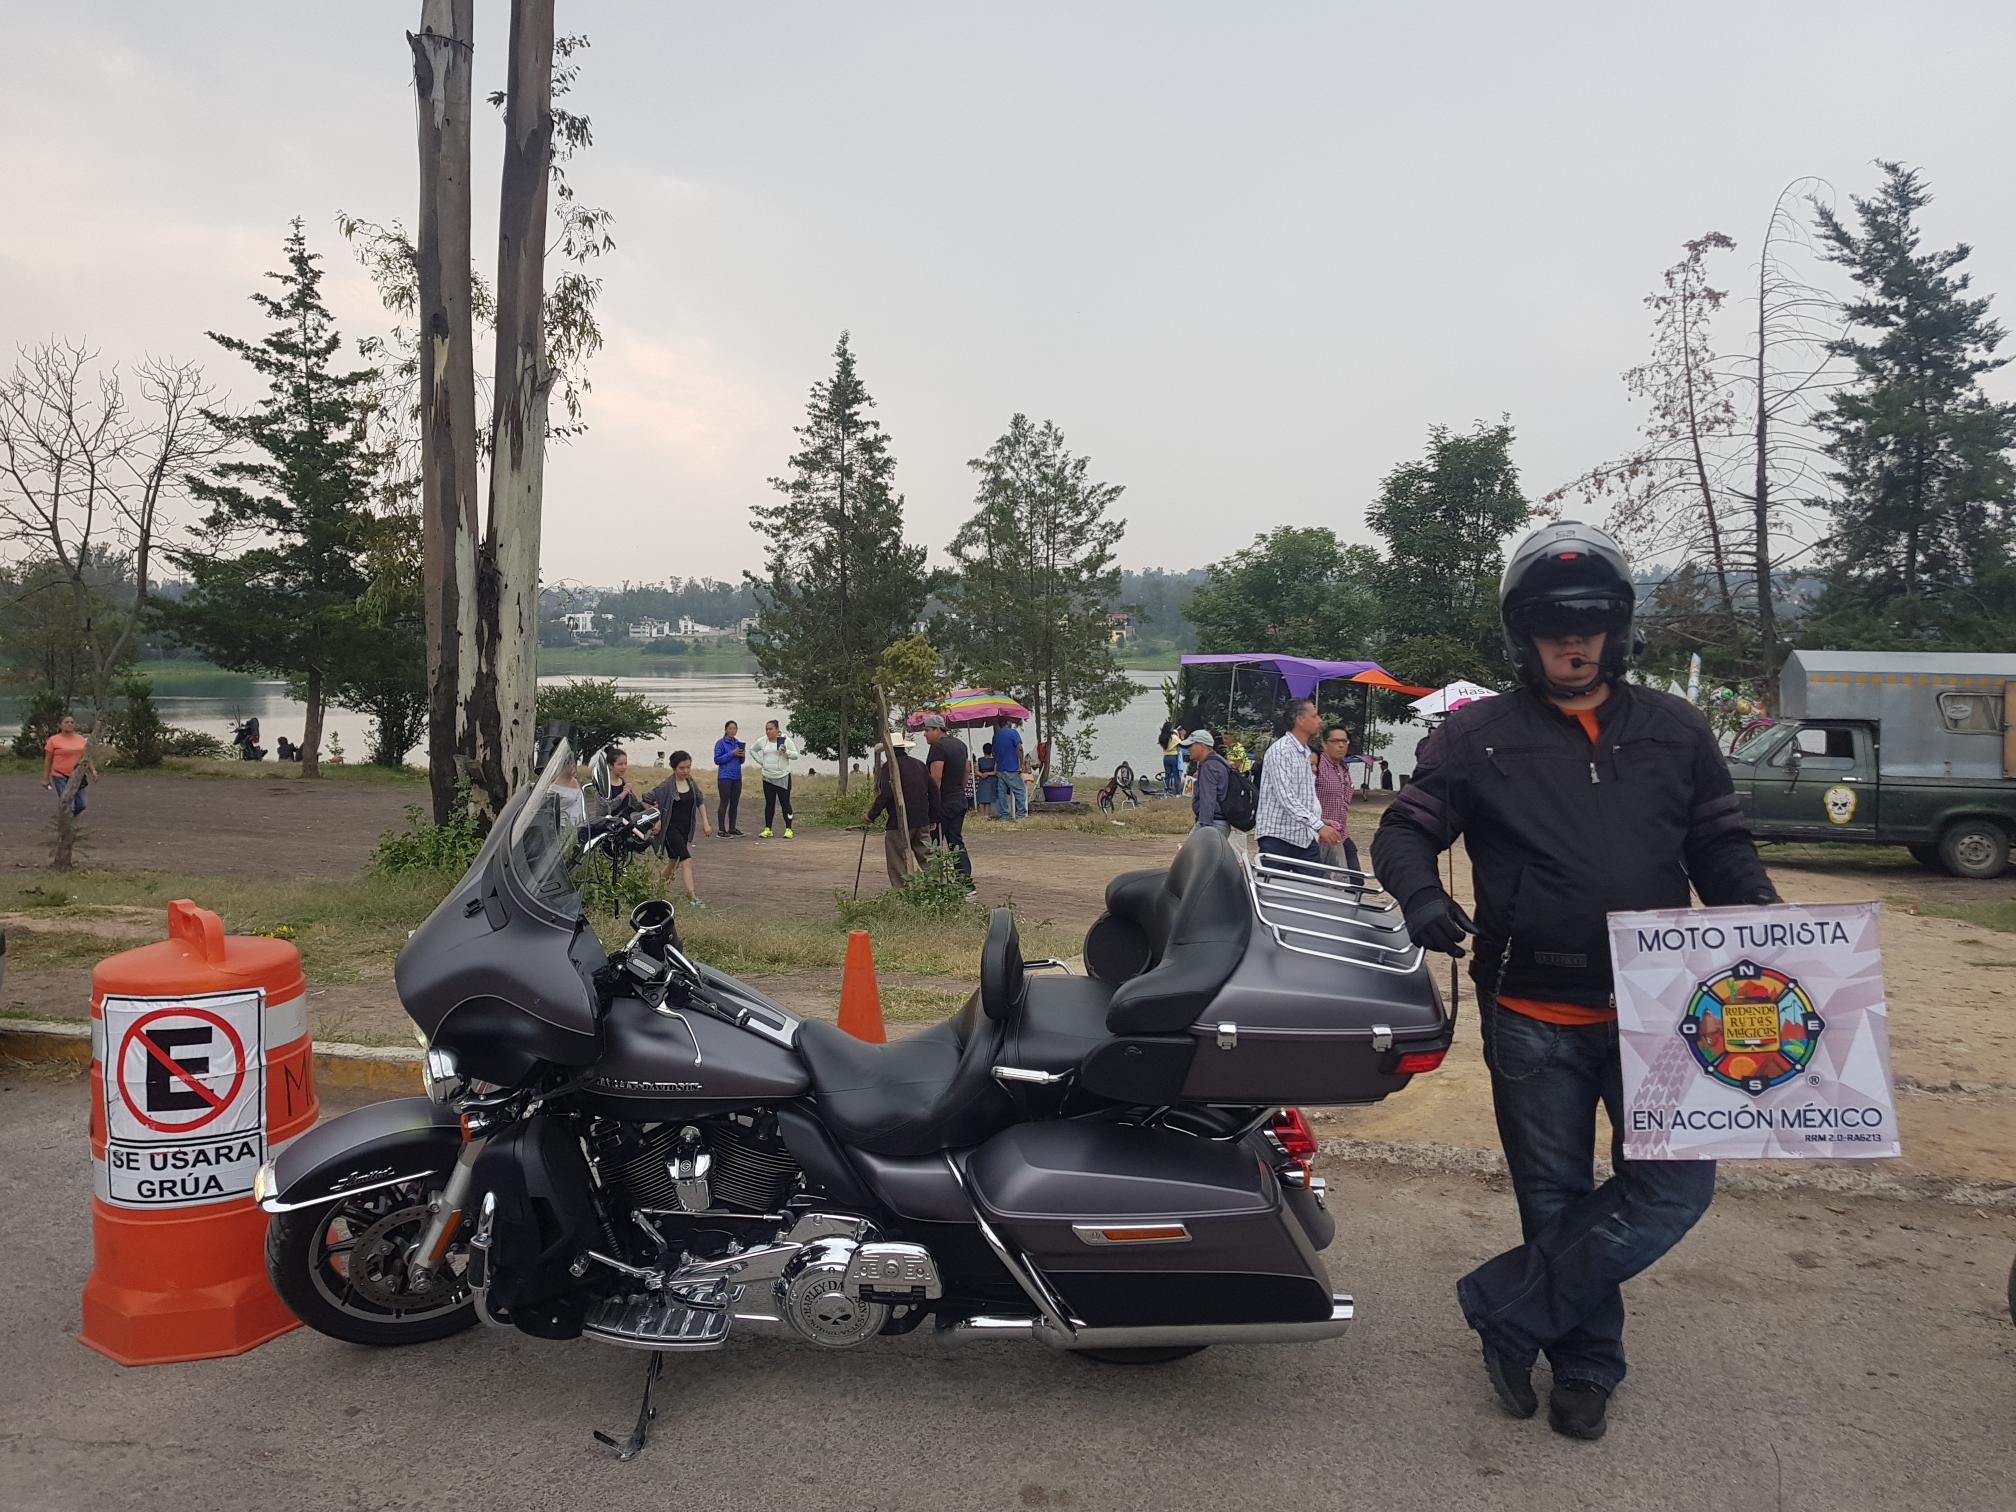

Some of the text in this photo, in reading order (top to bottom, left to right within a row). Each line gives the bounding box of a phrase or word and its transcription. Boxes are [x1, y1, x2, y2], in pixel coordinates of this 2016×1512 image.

[1637, 921, 1850, 952] MOTO TURISTA
[1739, 965, 1755, 976] N
[1807, 1020, 1821, 1031] E
[1749, 1080, 1762, 1090] S
[1633, 1103, 1883, 1131] EN ACCIÓN MÉXICO
[112, 1150, 141, 1171] SE
[137, 1173, 224, 1199] GRÚA
